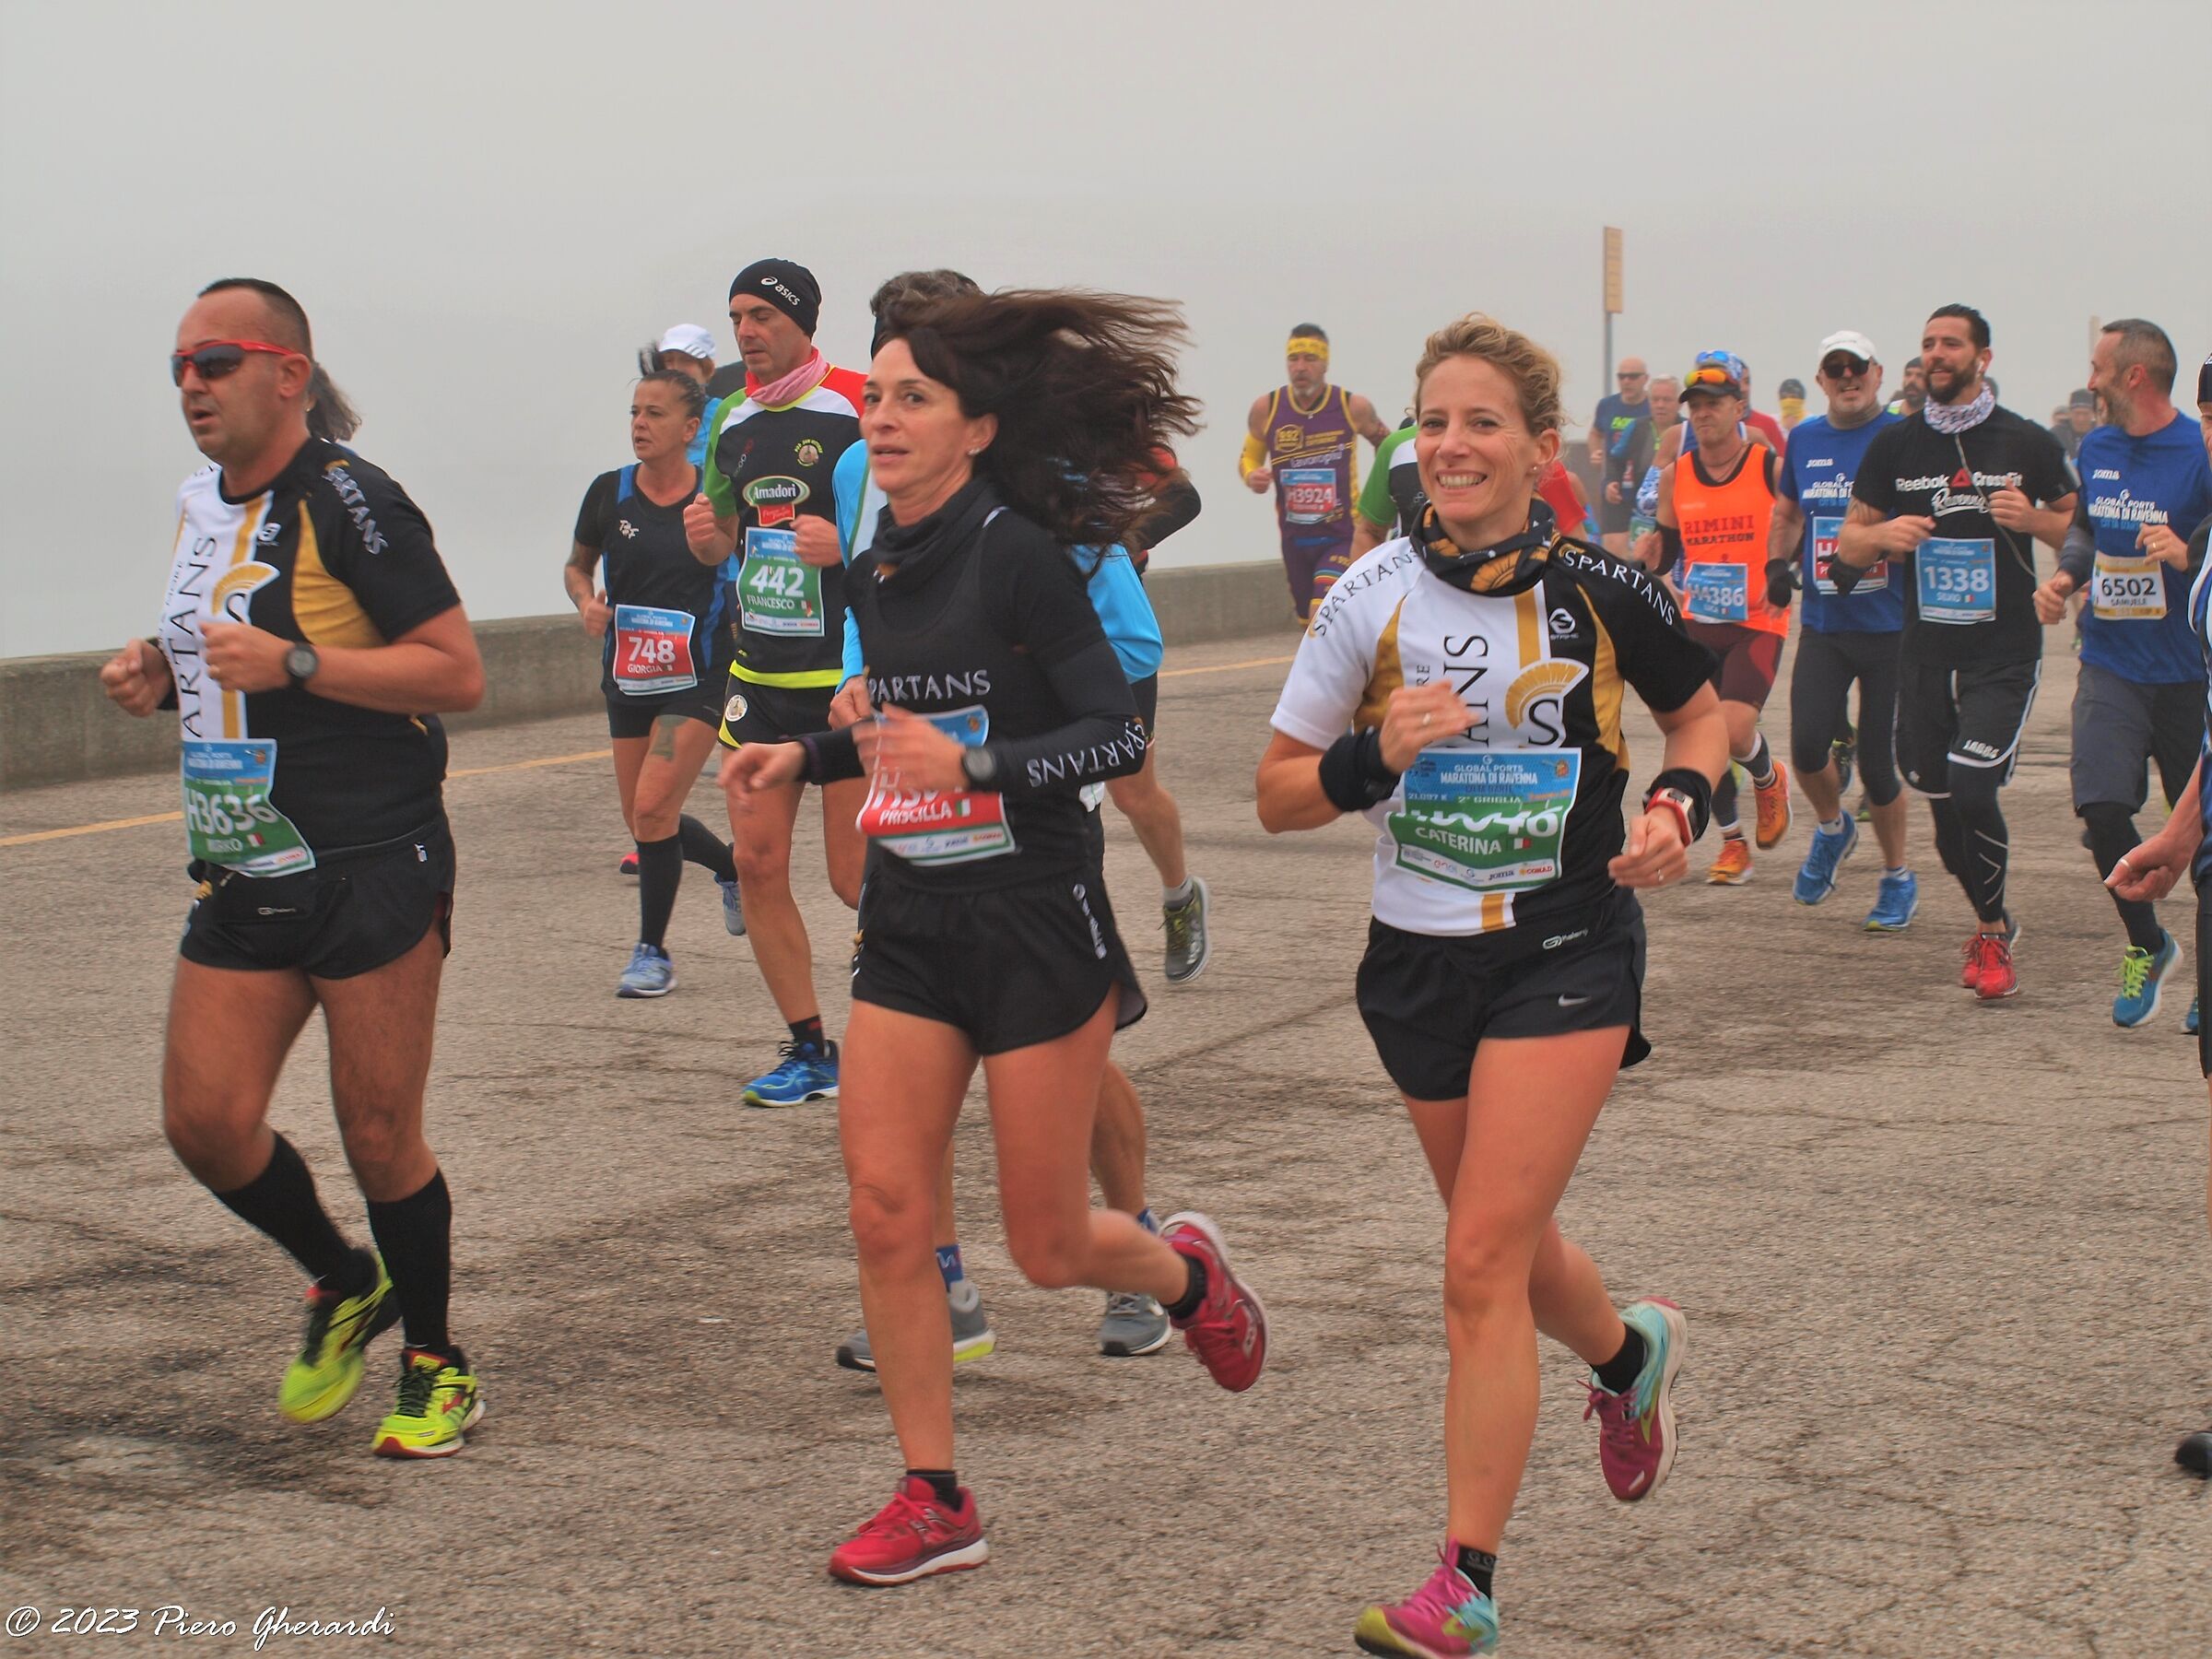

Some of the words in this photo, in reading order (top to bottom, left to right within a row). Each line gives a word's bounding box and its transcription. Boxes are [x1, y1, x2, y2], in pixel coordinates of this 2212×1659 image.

[775, 284, 800, 306] asics
[1895, 475, 1949, 491] Reebok
[1971, 471, 2023, 487] CrossFit
[754, 484, 795, 500] Amadori
[1684, 515, 1754, 535] RIMINI
[1686, 532, 1755, 546] MARATHON
[749, 564, 805, 597] 442
[1564, 550, 1675, 626] SPARTANS
[1924, 565, 1990, 593] 1338
[2101, 577, 2157, 596] 6502
[747, 594, 794, 609] FRANCESCO
[628, 636, 676, 664] 748
[627, 664, 663, 675] GIORGIA
[867, 669, 992, 703] PARTANS
[1441, 771, 1487, 784] MARATONA
[1488, 772, 1498, 783] DI
[1499, 772, 1537, 784] RAVENNA
[1493, 764, 1524, 772] PORTS
[1474, 795, 1522, 804] GRIGLIA
[187, 789, 277, 835] H3636
[878, 799, 953, 827] PRISCILLA
[1415, 827, 1502, 855] CATERINA
